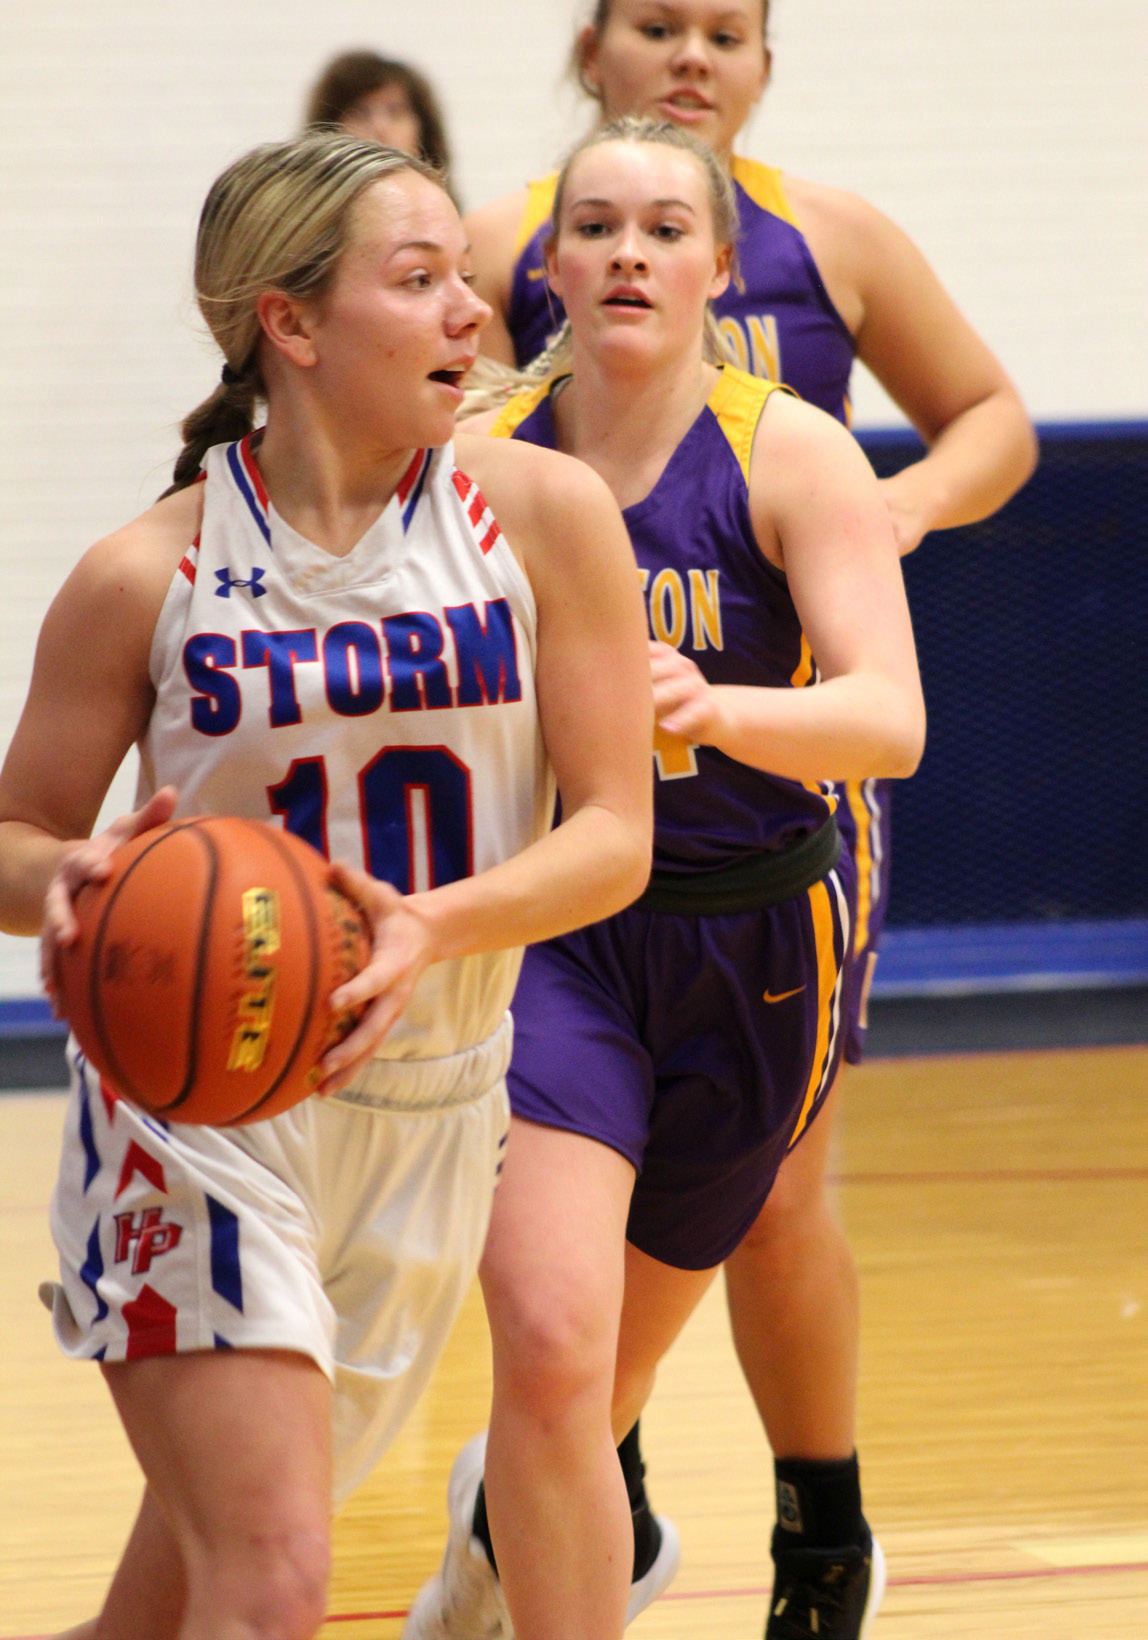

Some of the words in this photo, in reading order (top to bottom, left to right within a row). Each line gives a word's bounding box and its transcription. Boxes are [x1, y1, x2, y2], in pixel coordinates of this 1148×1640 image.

[637, 568, 724, 652] ON
[183, 597, 522, 737] STORM
[113, 1206, 183, 1276] HP
